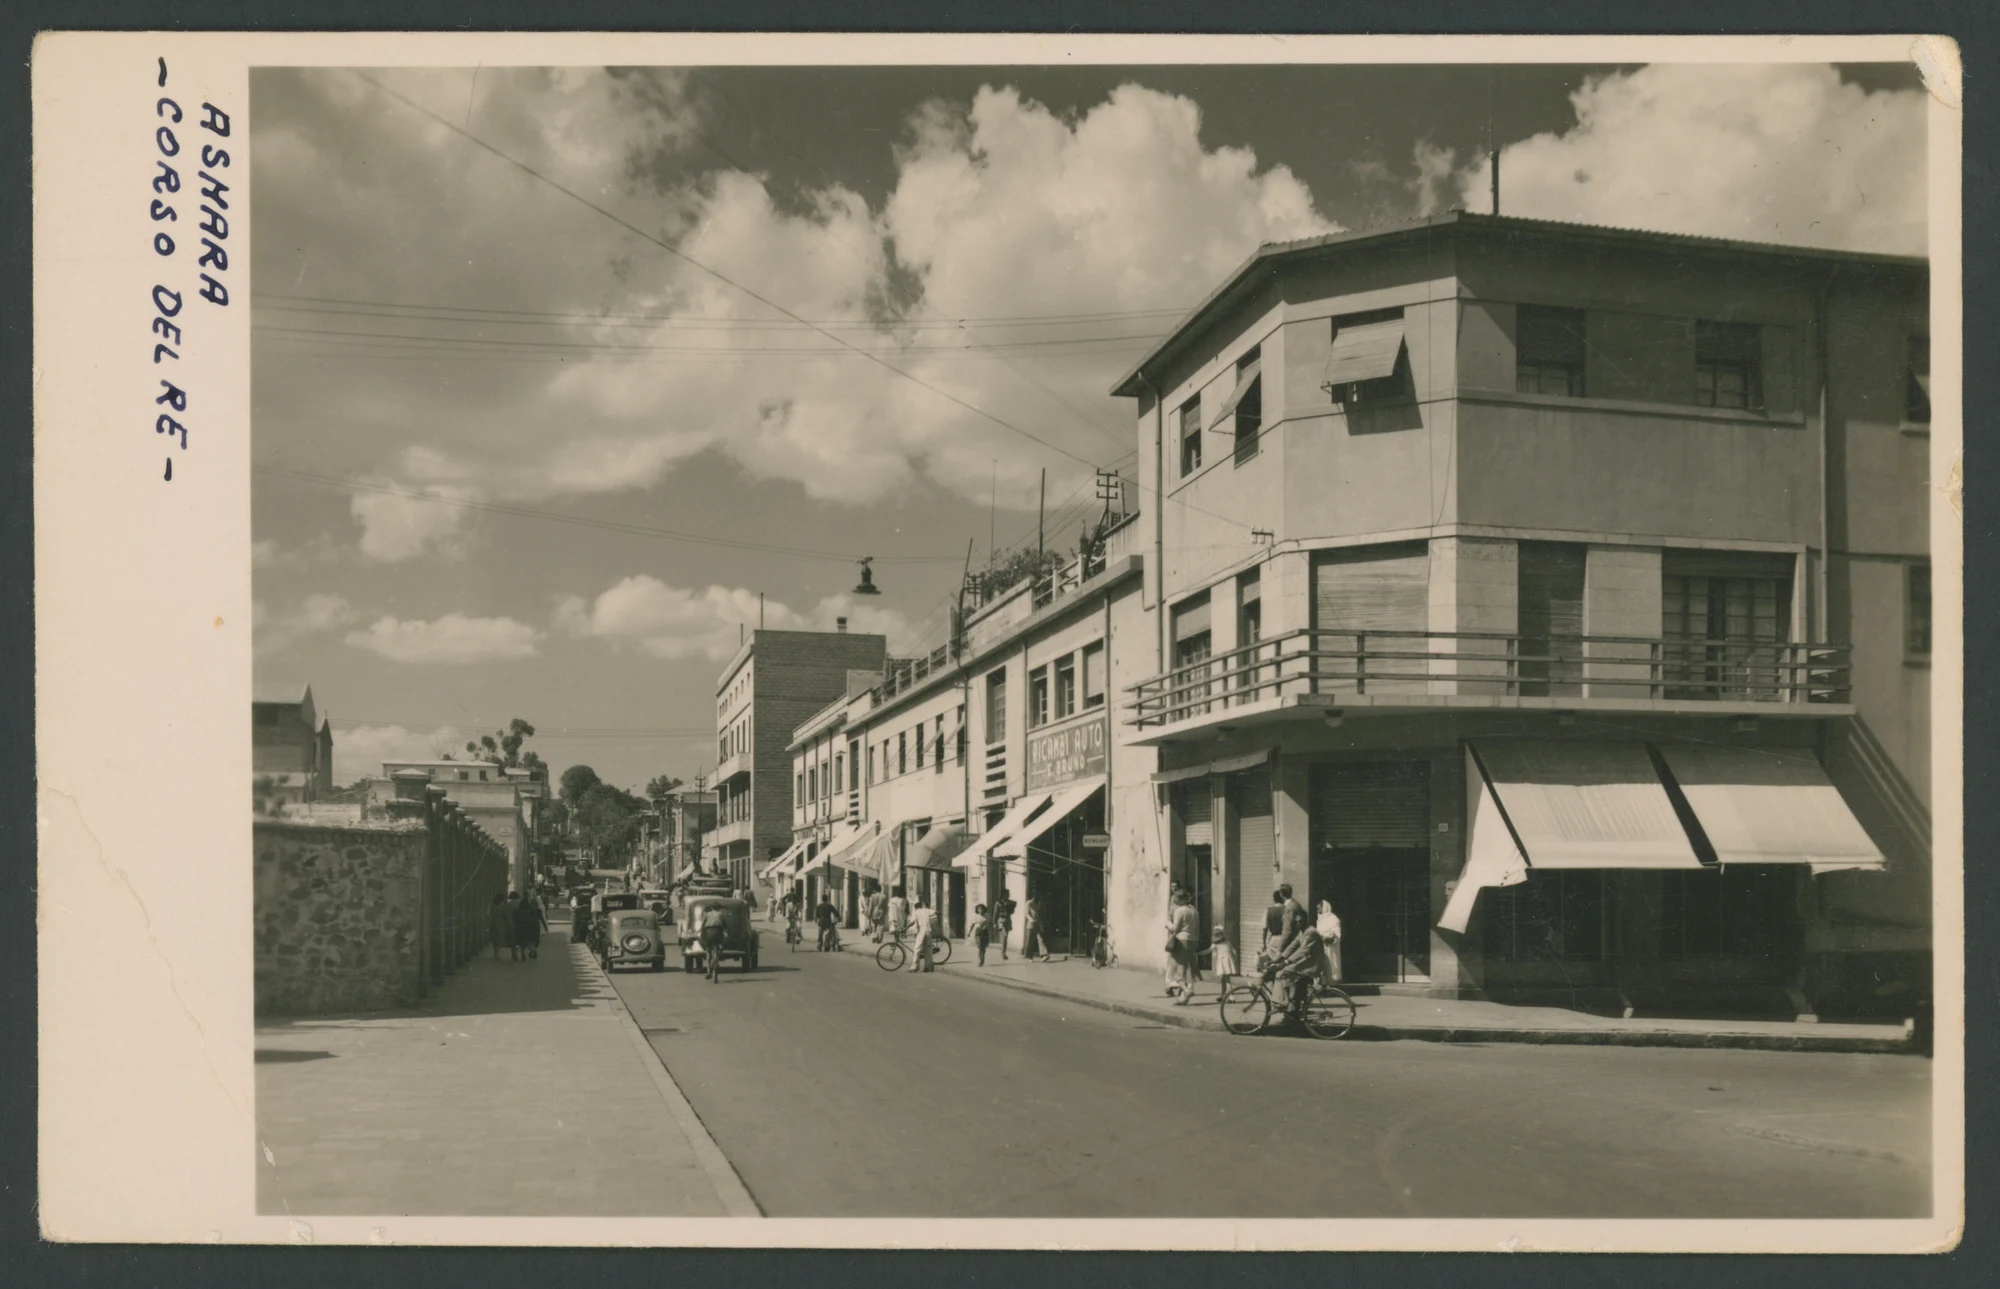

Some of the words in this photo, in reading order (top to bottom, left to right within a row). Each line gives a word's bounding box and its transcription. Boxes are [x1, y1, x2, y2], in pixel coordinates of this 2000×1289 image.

[198, 102, 231, 307] ASMARA
[152, 285, 183, 364] DEL
[1033, 731, 1069, 764] RICAMBI
[1075, 723, 1103, 754] AUTO
[1056, 754, 1086, 775] BRUNO
